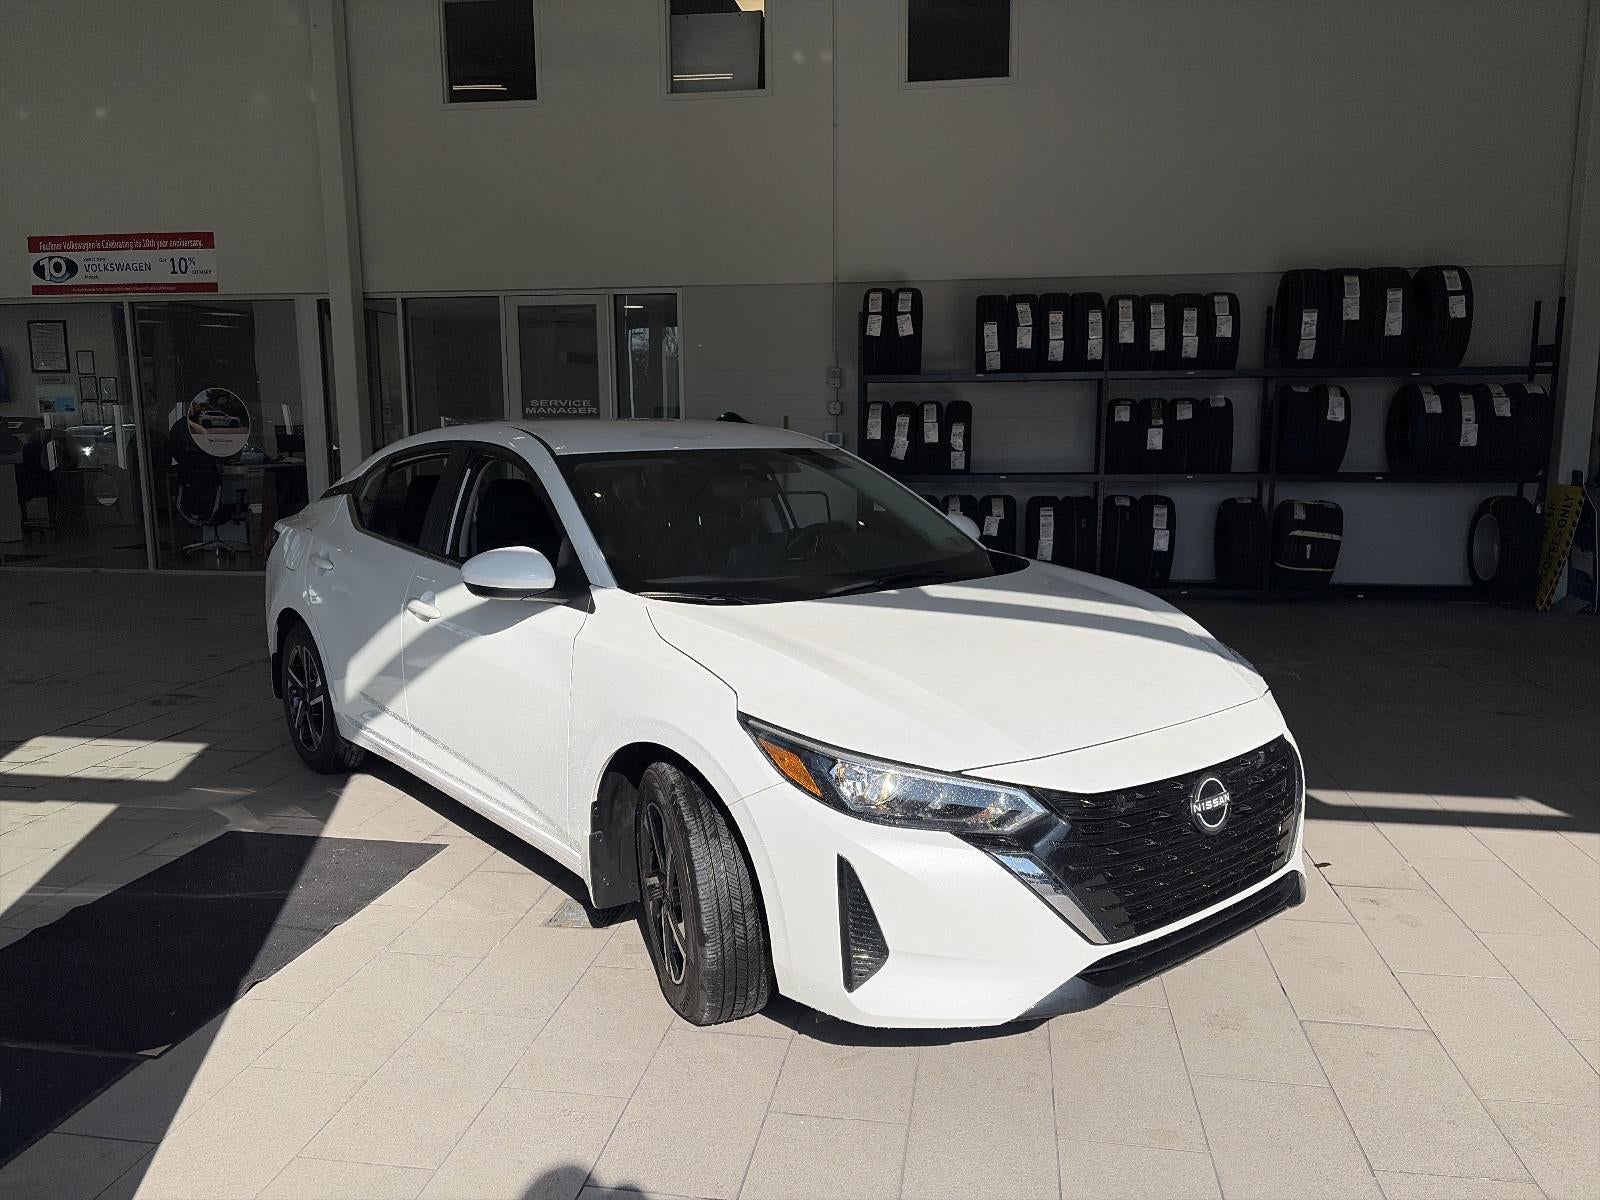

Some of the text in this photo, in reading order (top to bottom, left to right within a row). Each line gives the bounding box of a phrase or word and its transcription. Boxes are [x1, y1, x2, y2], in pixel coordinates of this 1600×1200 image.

[63, 240, 96, 252] Volkswagen
[101, 239, 133, 250] Celebrating
[142, 238, 156, 248] 10th
[156, 239, 169, 250] year
[39, 257, 67, 281] 10
[83, 262, 152, 273] VOLKSWAGEN
[530, 399, 591, 407] SERVICE
[1557, 494, 1574, 528] ONLY
[1193, 792, 1230, 813] NISSAN
